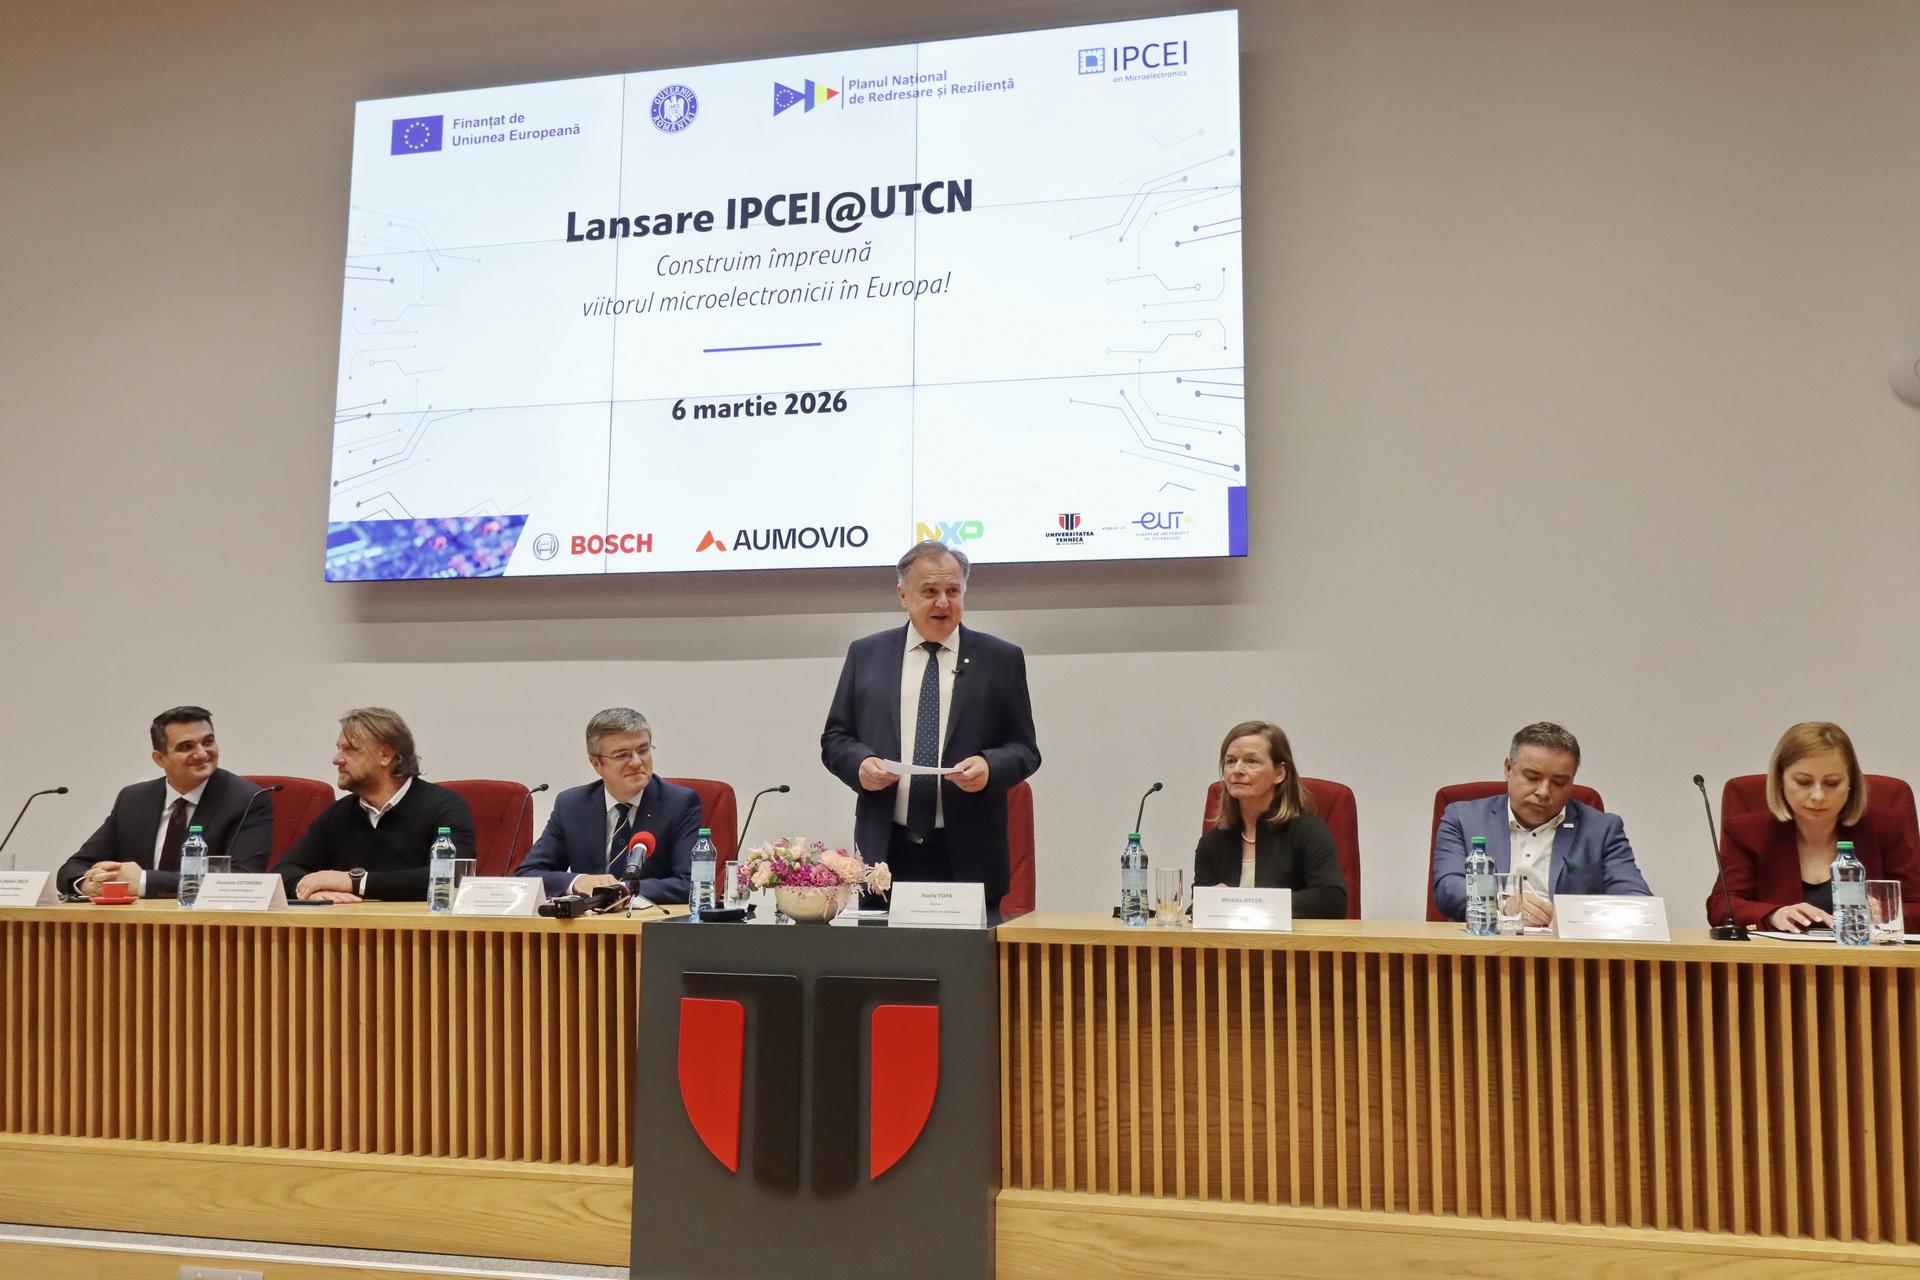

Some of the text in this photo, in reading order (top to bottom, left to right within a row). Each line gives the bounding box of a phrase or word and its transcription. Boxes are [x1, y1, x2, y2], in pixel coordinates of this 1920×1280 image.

[1113, 40, 1188, 72] IPCEI
[848, 69, 947, 90] Planul Național
[1125, 70, 1188, 82] Microelectronics
[654, 86, 695, 105] GUVERNUL
[848, 78, 1015, 104] de Redresare și Reziliență
[452, 112, 525, 130] Finanțat de
[452, 123, 581, 147] Uniunea Europeană
[566, 179, 973, 243] Lansare IPCEI@UTCN
[656, 241, 873, 277] Construim împreună
[582, 272, 952, 317] viitorul microelectronicii în Europa!
[672, 390, 849, 421] 6 martie 2026
[571, 533, 653, 555] BOSCH
[733, 526, 869, 552] AUMOVIO
[916, 520, 985, 545] NXP
